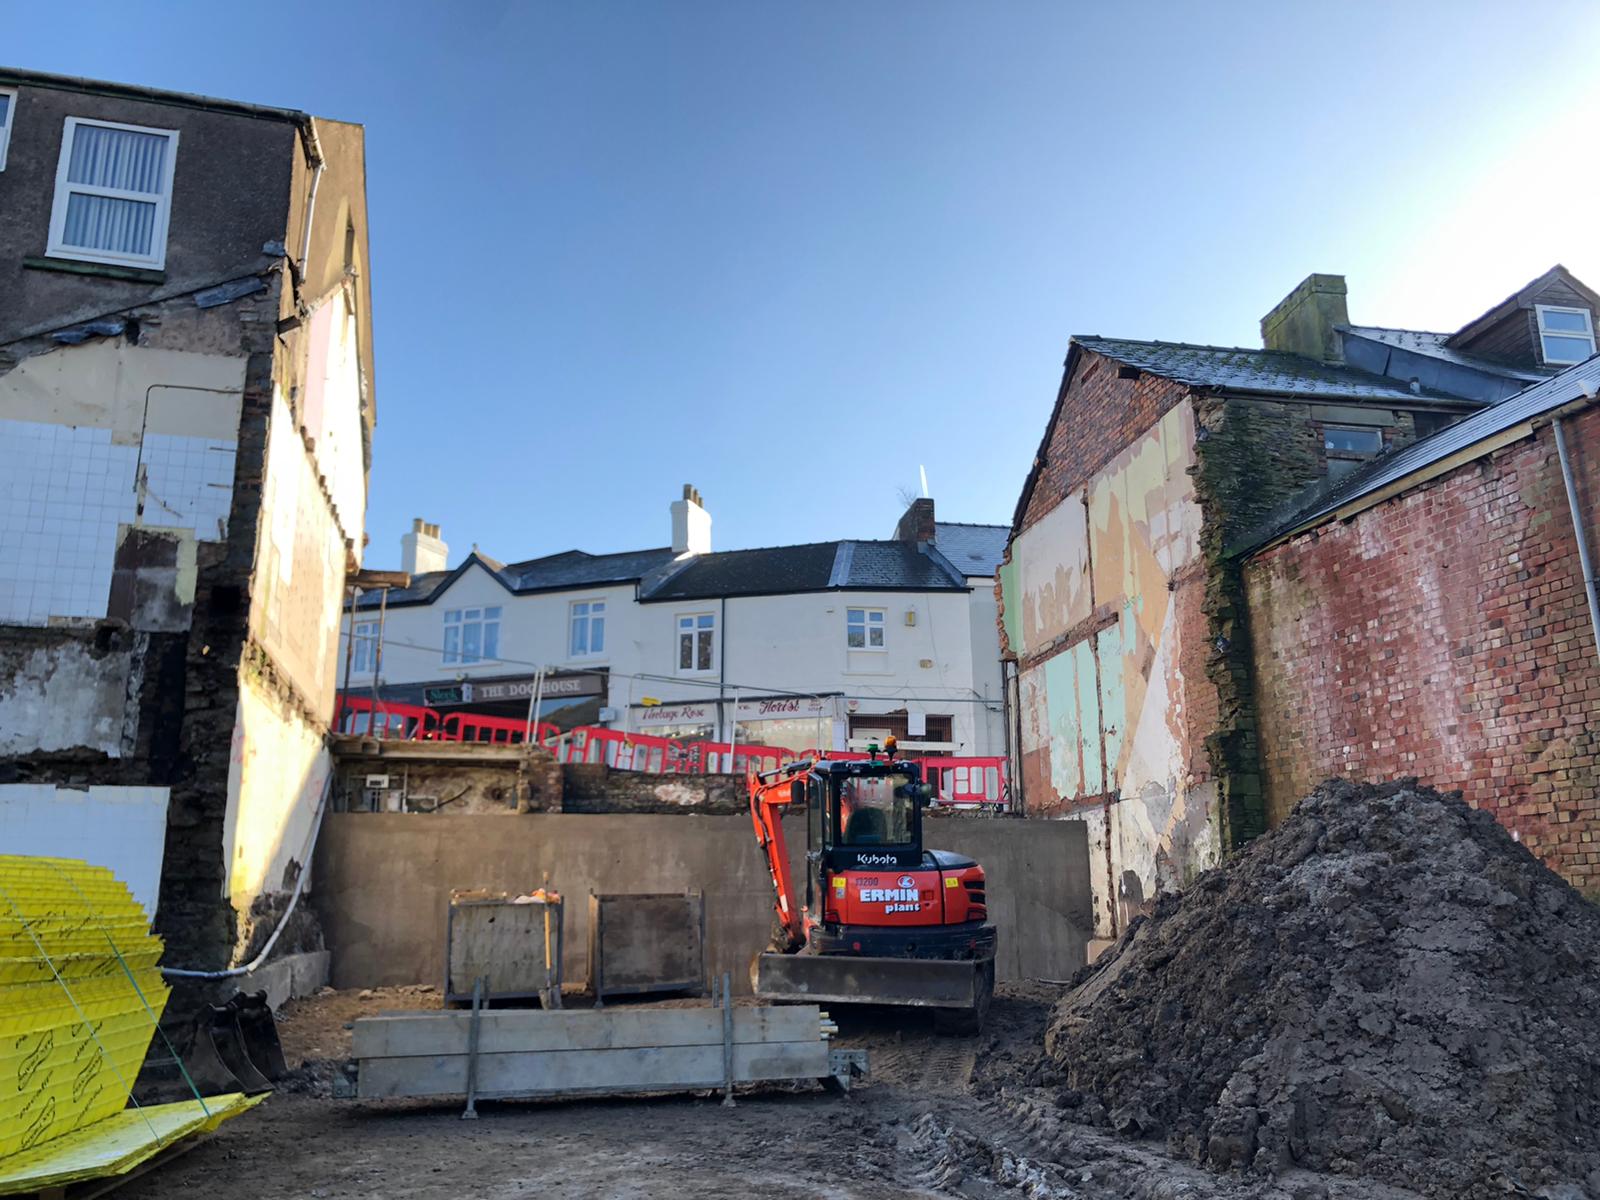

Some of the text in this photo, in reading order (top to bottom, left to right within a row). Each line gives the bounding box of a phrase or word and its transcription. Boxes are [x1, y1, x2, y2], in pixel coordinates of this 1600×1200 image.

[481, 685, 505, 698] THE
[540, 680, 580, 694] HOUSE
[681, 704, 705, 719] Rose
[760, 698, 800, 714] Florist
[857, 854, 897, 864] Kubota
[860, 888, 919, 902] ERMIN
[884, 903, 921, 915] plant
